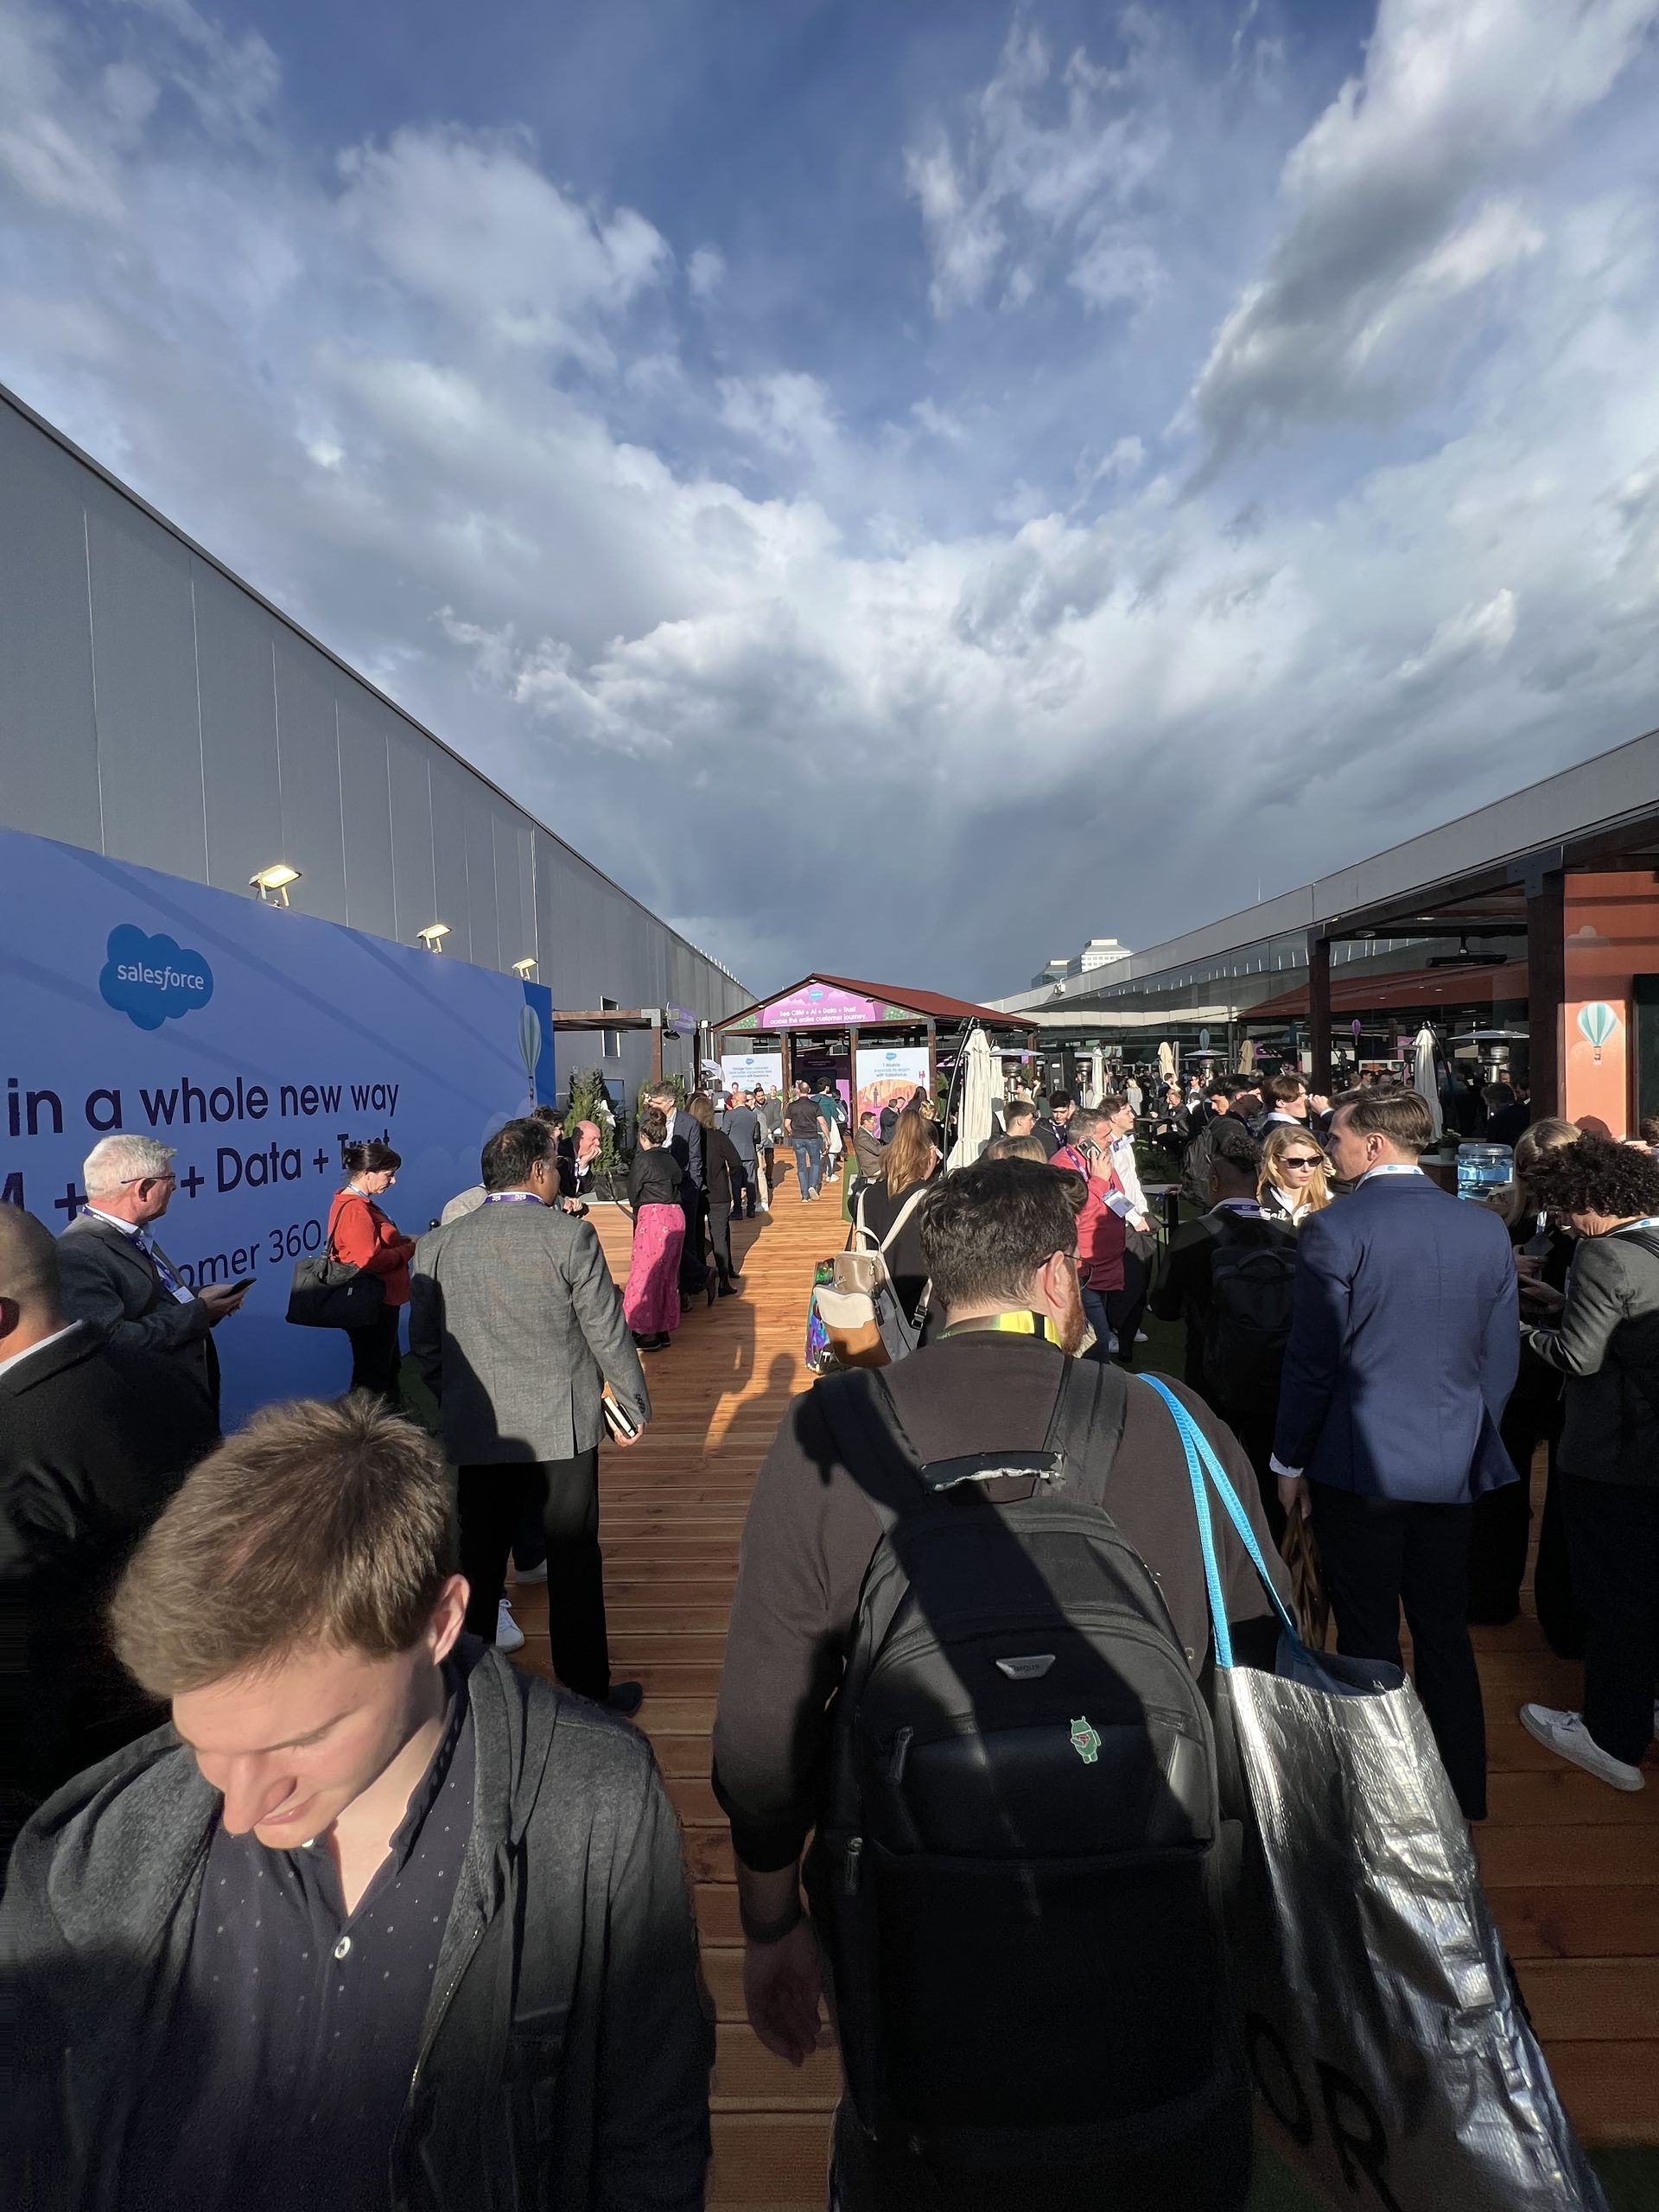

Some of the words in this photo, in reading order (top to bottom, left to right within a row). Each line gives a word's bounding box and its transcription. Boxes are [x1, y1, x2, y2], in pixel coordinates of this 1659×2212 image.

[117, 962, 205, 991] salesforce
[8, 1077, 63, 1137] in
[85, 1089, 123, 1132] a
[138, 1077, 269, 1127] whole
[280, 1084, 342, 1117] new
[350, 1084, 399, 1117] way
[217, 1141, 302, 1193] Data
